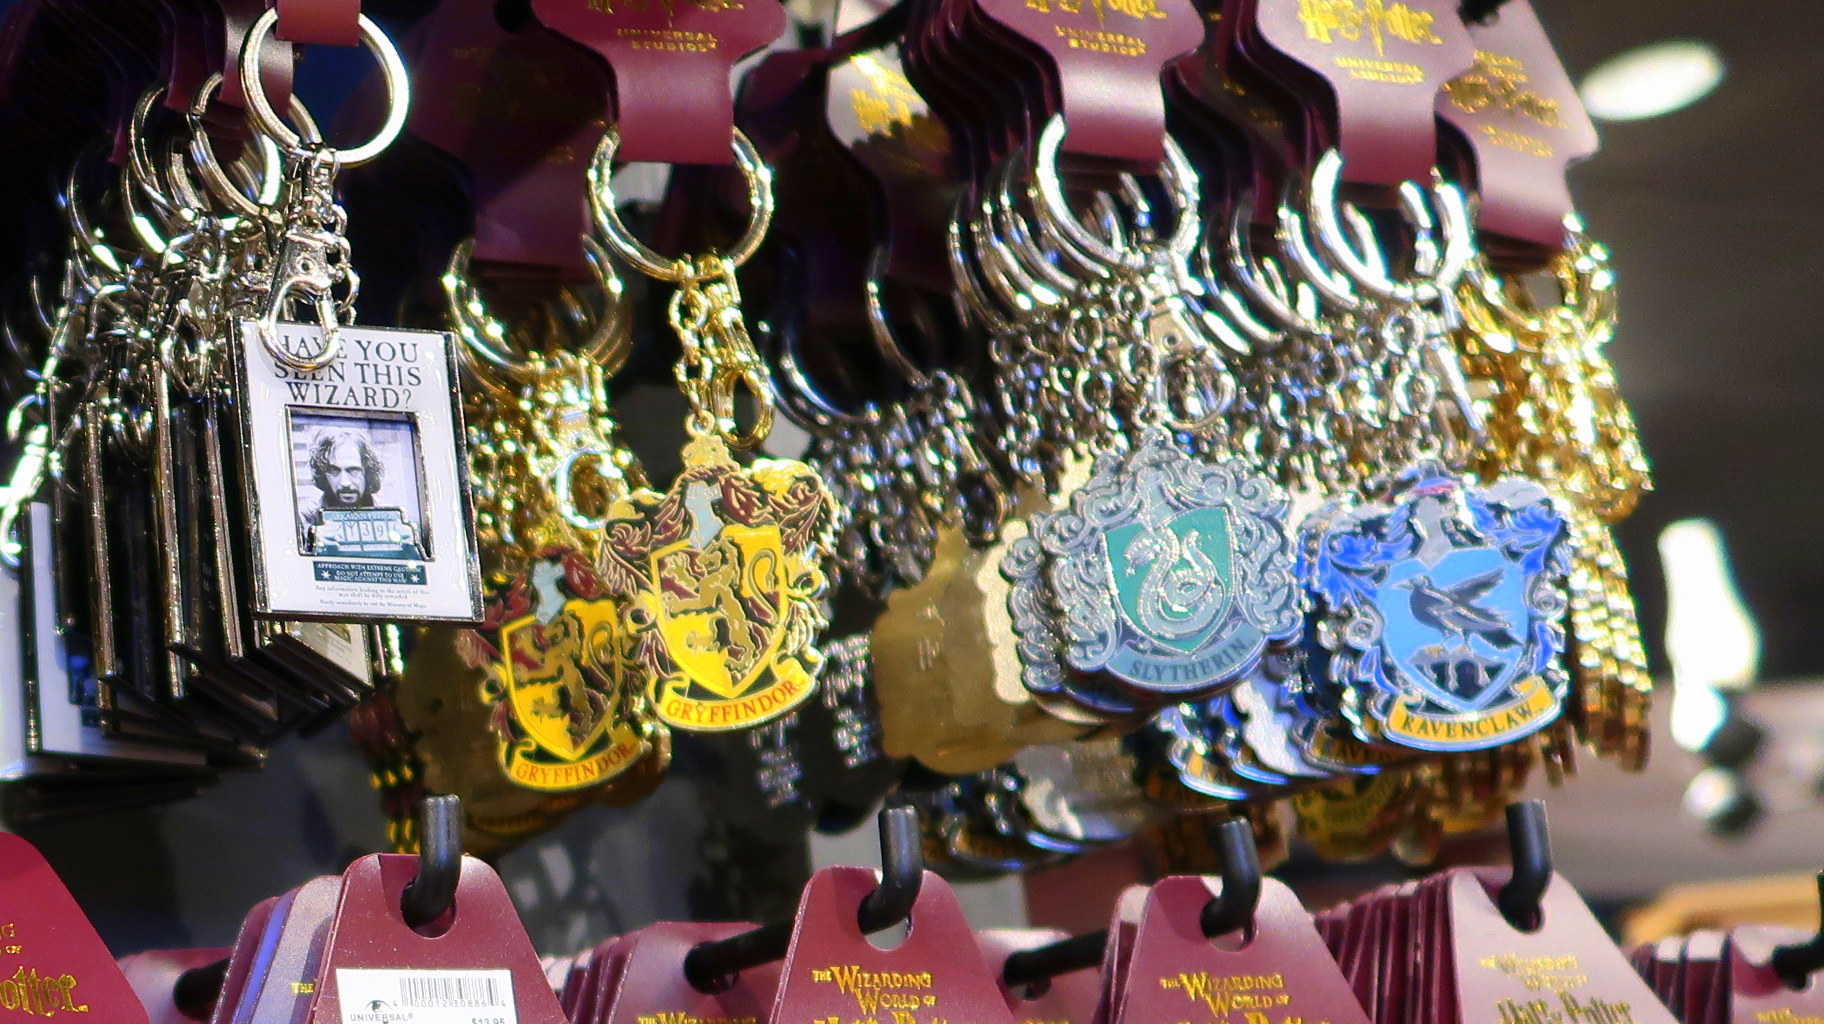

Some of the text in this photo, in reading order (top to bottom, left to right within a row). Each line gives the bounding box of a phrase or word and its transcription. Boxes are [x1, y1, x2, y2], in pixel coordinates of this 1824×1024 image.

[354, 339, 418, 363] YOU
[354, 363, 422, 387] THIS
[286, 381, 412, 410] WIZARD?
[1129, 637, 1251, 682] SLYTHERIN
[666, 679, 801, 724] GRYFFINDOR
[1402, 702, 1535, 742] RAVENCLAW
[515, 745, 631, 785] GRYFFINDOR
[5, 945, 22, 955] OF
[830, 964, 933, 995] WIZARDING
[854, 987, 920, 1015] WORLD
